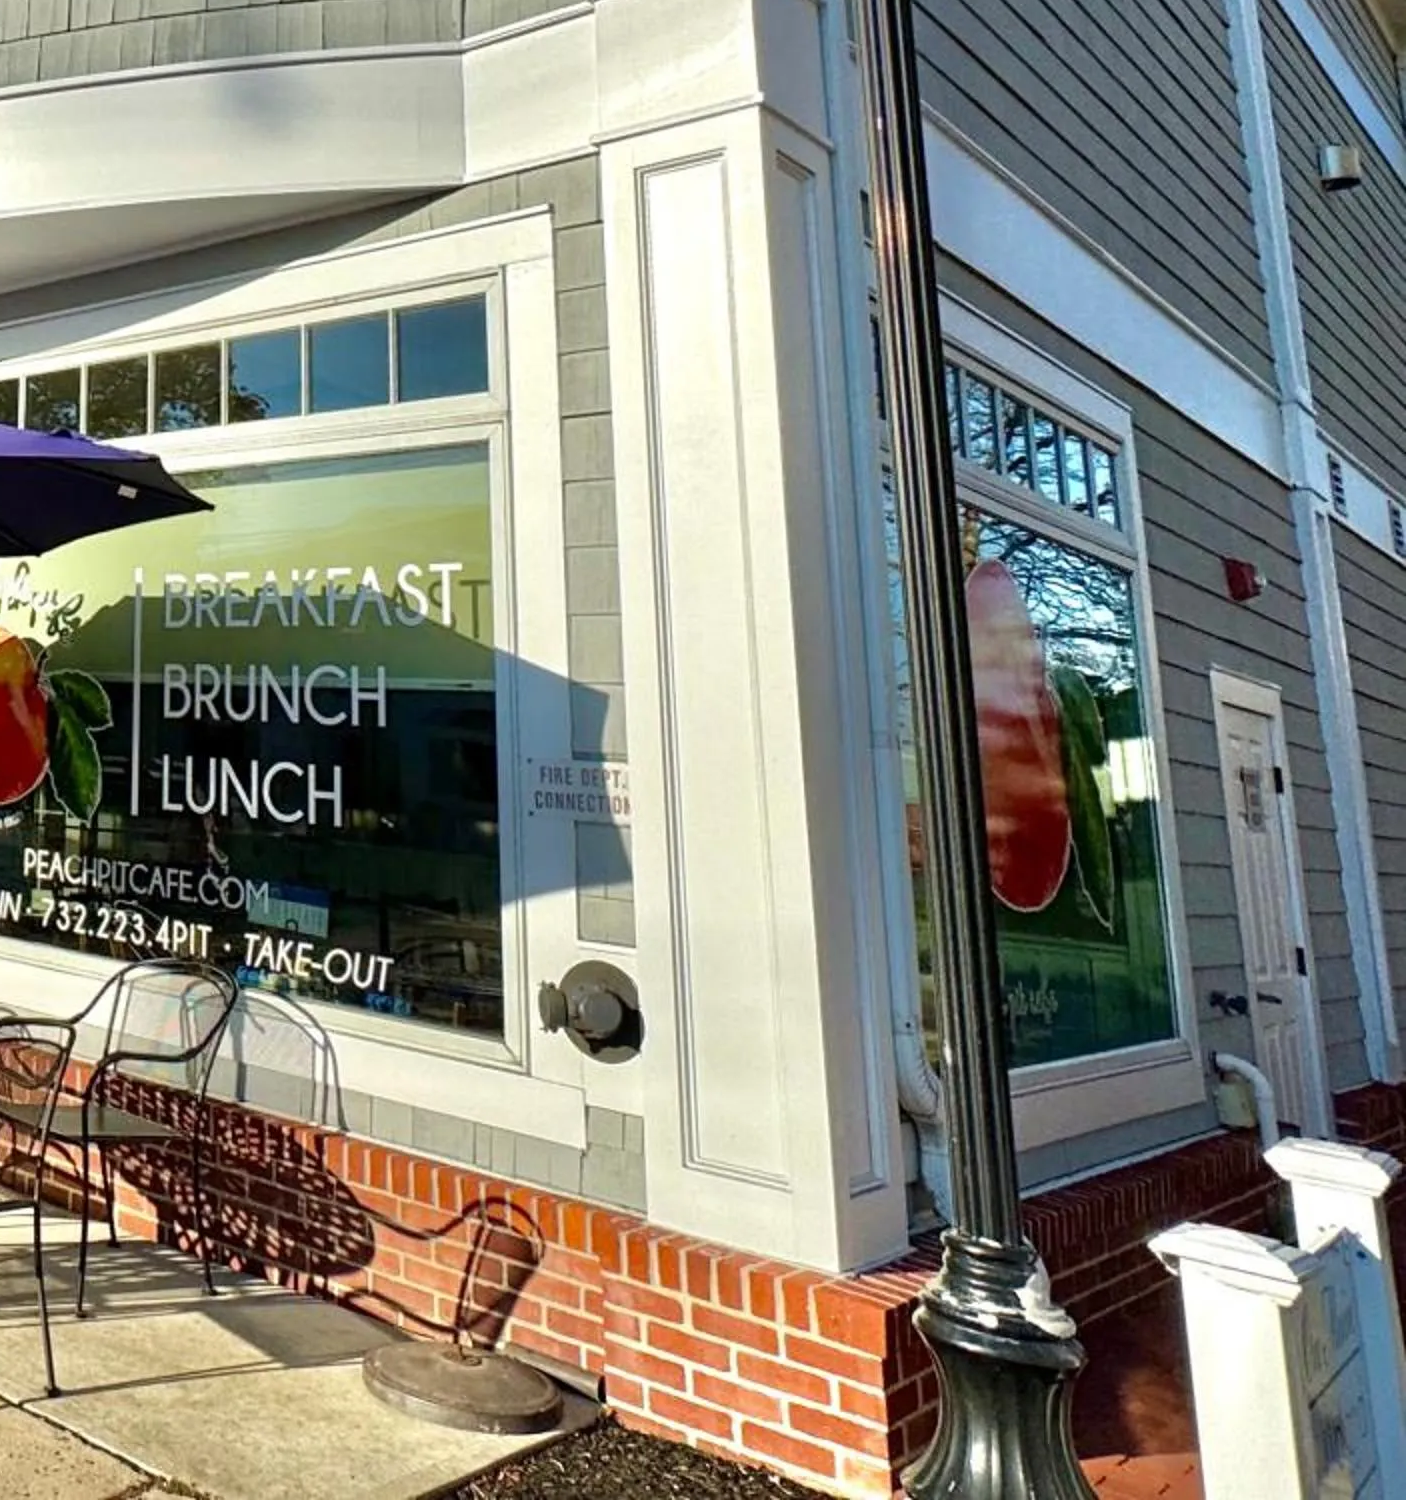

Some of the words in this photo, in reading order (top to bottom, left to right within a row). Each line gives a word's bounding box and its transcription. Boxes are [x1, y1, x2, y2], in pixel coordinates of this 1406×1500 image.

[163, 562, 463, 629] BREAKFAST
[163, 663, 387, 728] BRUNCH
[161, 754, 343, 828] LUNCH
[533, 790, 631, 815] CONNECTION
[539, 765, 573, 785] FIRE
[23, 847, 270, 914] PEACHPITCAFE.COM
[41, 897, 213, 959] 732.223.4PIT
[243, 932, 394, 993] TAKE-OUT
